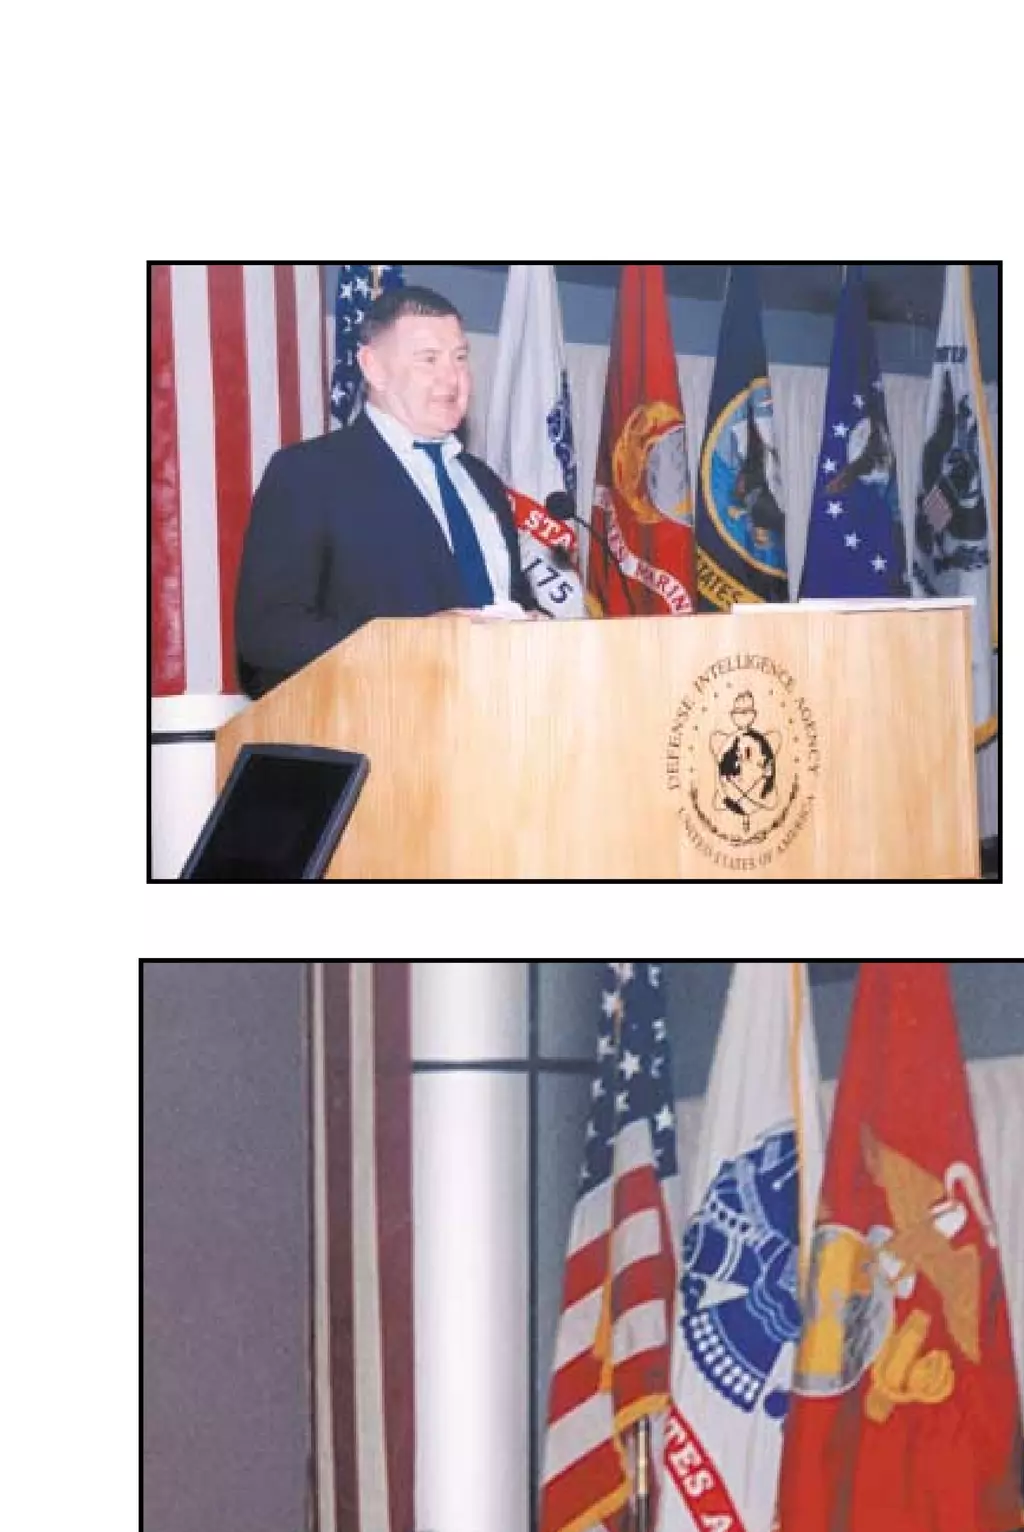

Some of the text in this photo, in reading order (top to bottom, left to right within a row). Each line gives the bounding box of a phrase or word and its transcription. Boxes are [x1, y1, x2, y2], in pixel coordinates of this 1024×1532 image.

[666, 652, 822, 791] DEFENSE INTELLIGENCE AGENCY
